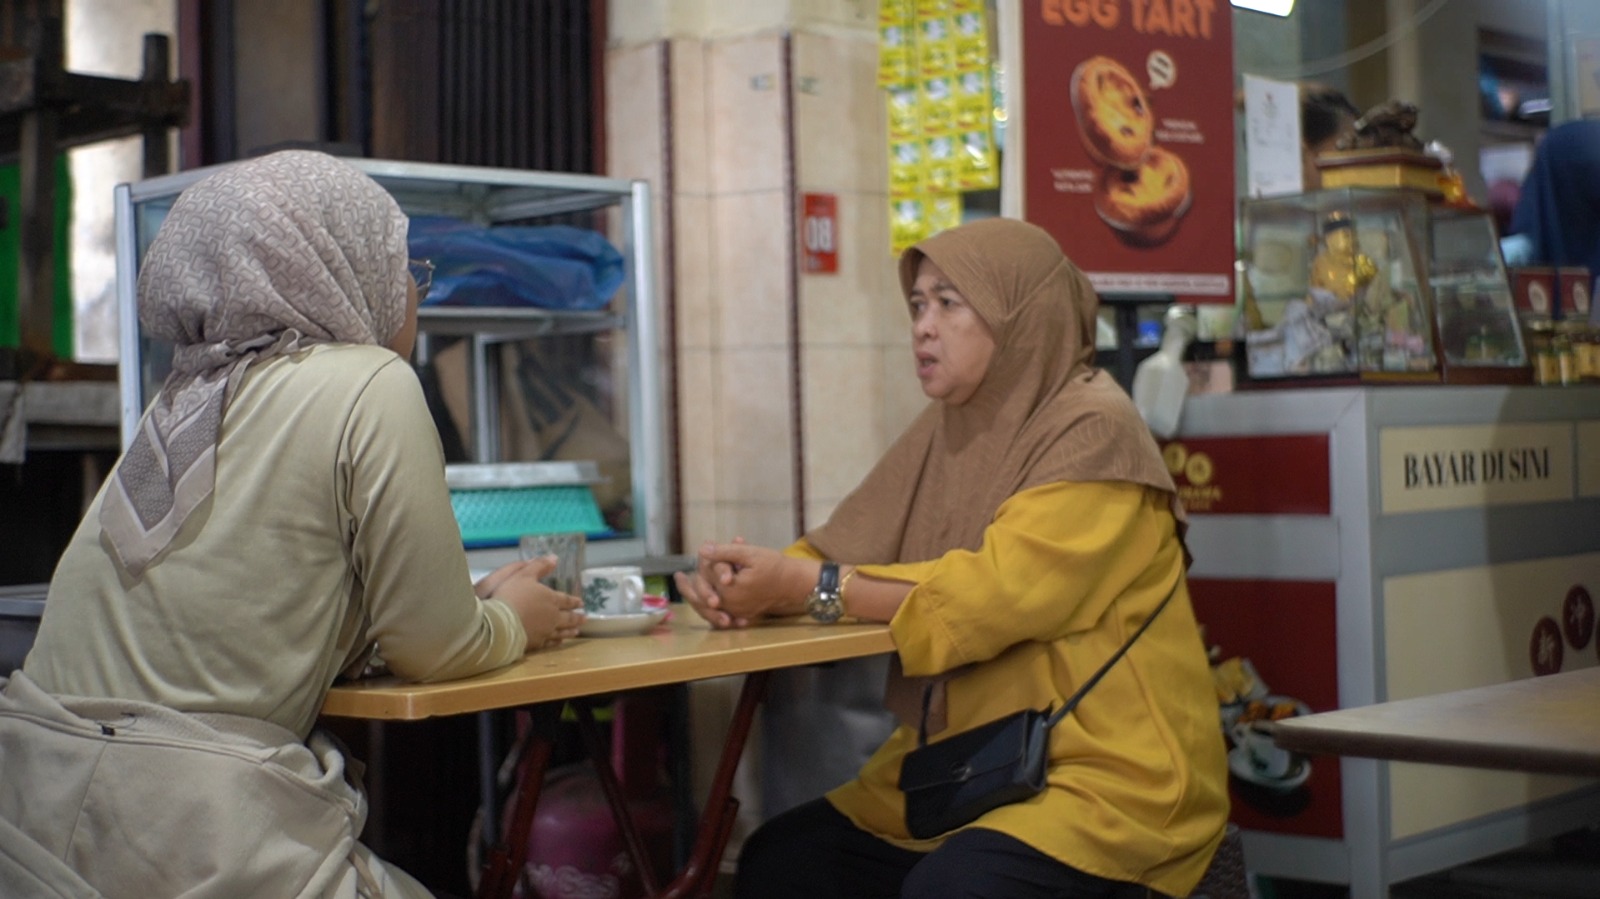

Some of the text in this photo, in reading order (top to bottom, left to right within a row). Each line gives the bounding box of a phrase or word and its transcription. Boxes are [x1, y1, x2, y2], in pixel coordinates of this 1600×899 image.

[1041, 0, 1215, 39] EGG TART
[1404, 447, 1549, 488] BAYAR DI SINI
